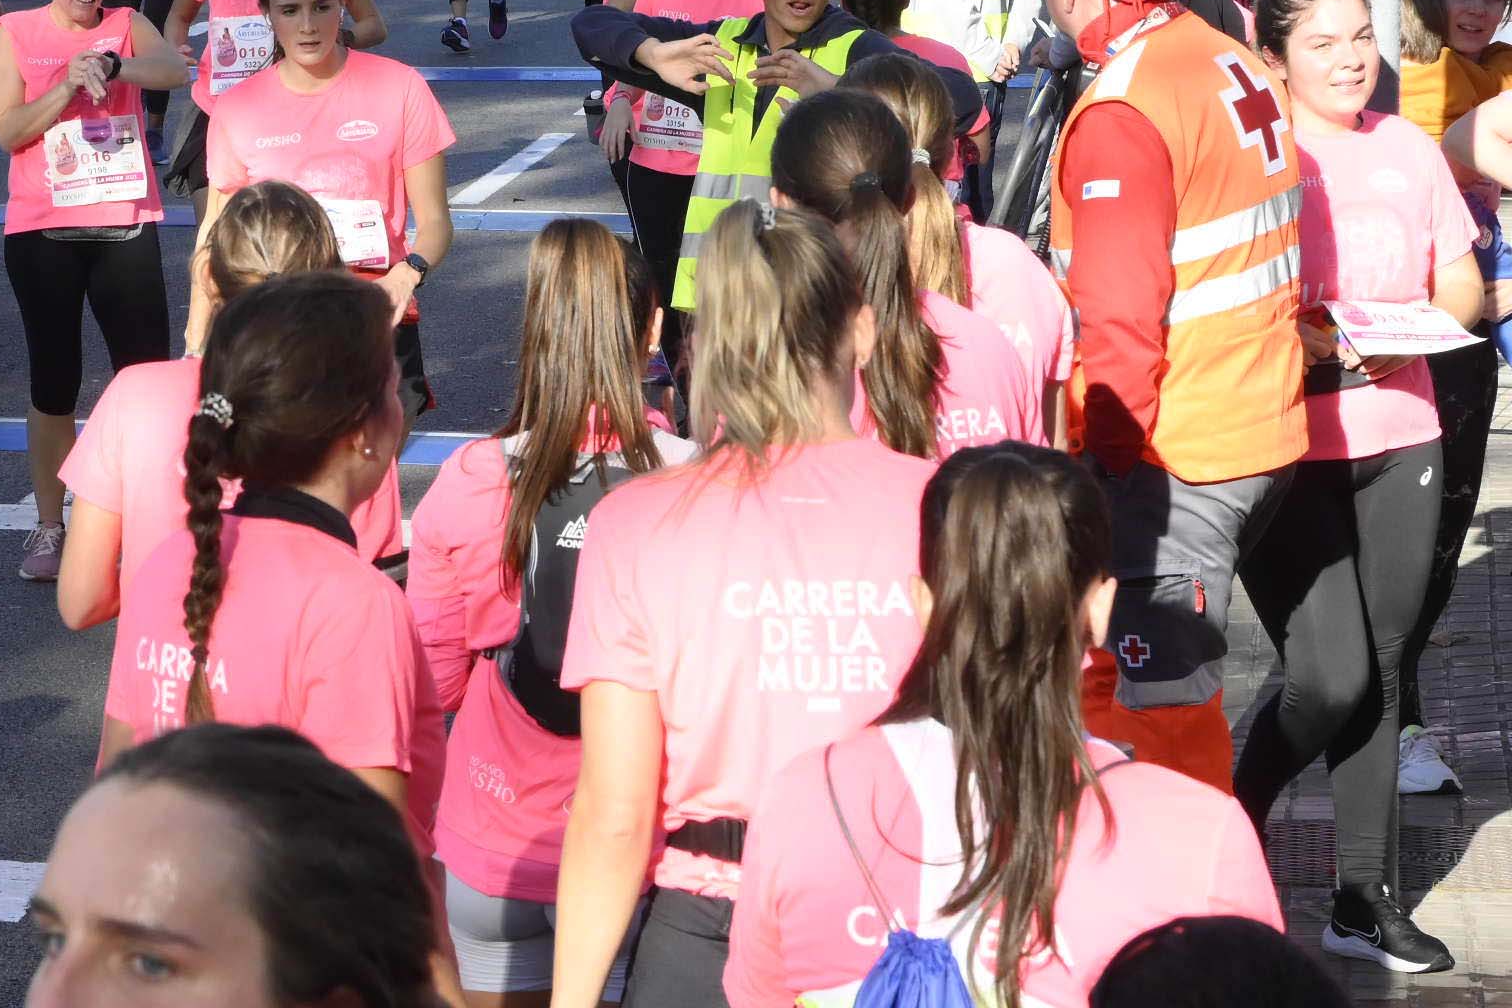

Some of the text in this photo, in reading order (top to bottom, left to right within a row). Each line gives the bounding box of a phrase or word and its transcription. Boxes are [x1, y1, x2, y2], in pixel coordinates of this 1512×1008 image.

[238, 47, 267, 58] 016
[665, 105, 690, 118] 016
[81, 151, 111, 165] 016
[724, 580, 914, 619] CARRERA
[762, 618, 878, 655] DE LA
[756, 656, 889, 692] MUJER
